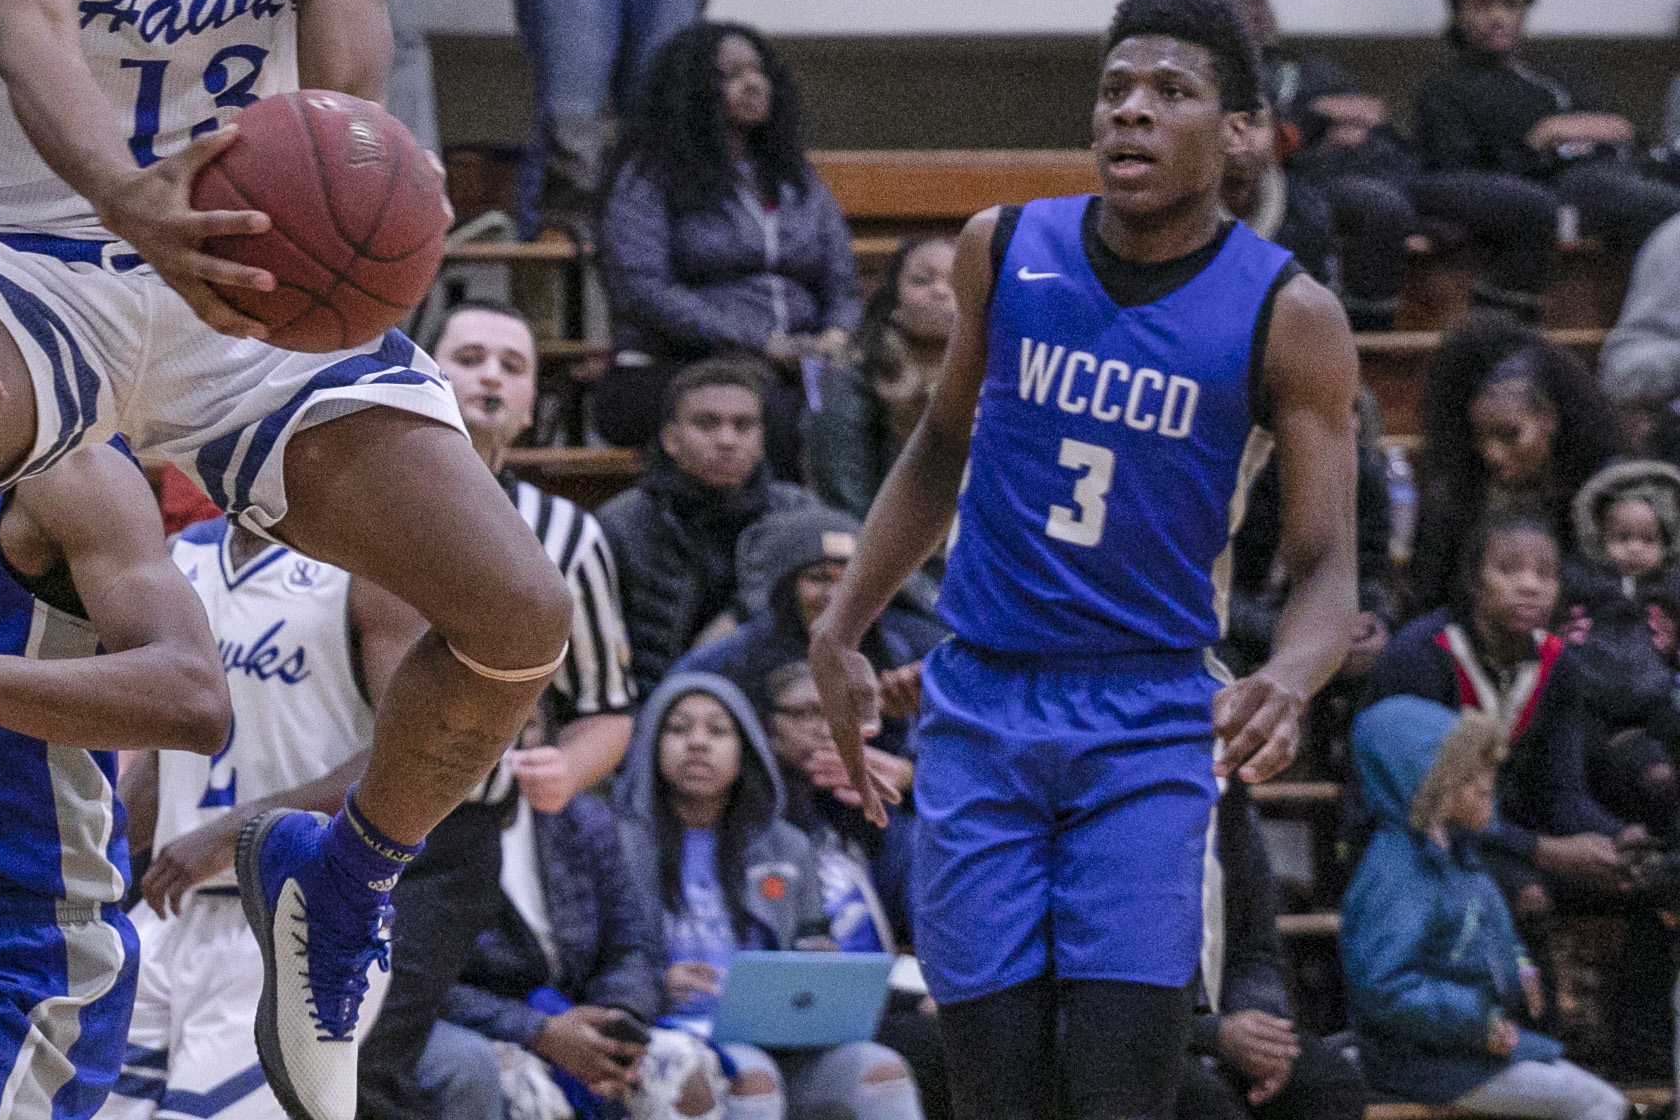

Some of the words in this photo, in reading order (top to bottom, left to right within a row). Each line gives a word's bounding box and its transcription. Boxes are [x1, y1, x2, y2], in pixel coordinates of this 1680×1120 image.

[121, 44, 270, 169] 13
[1019, 337, 1199, 439] WCCCD
[1045, 437, 1115, 547] 3
[219, 618, 311, 685] wks
